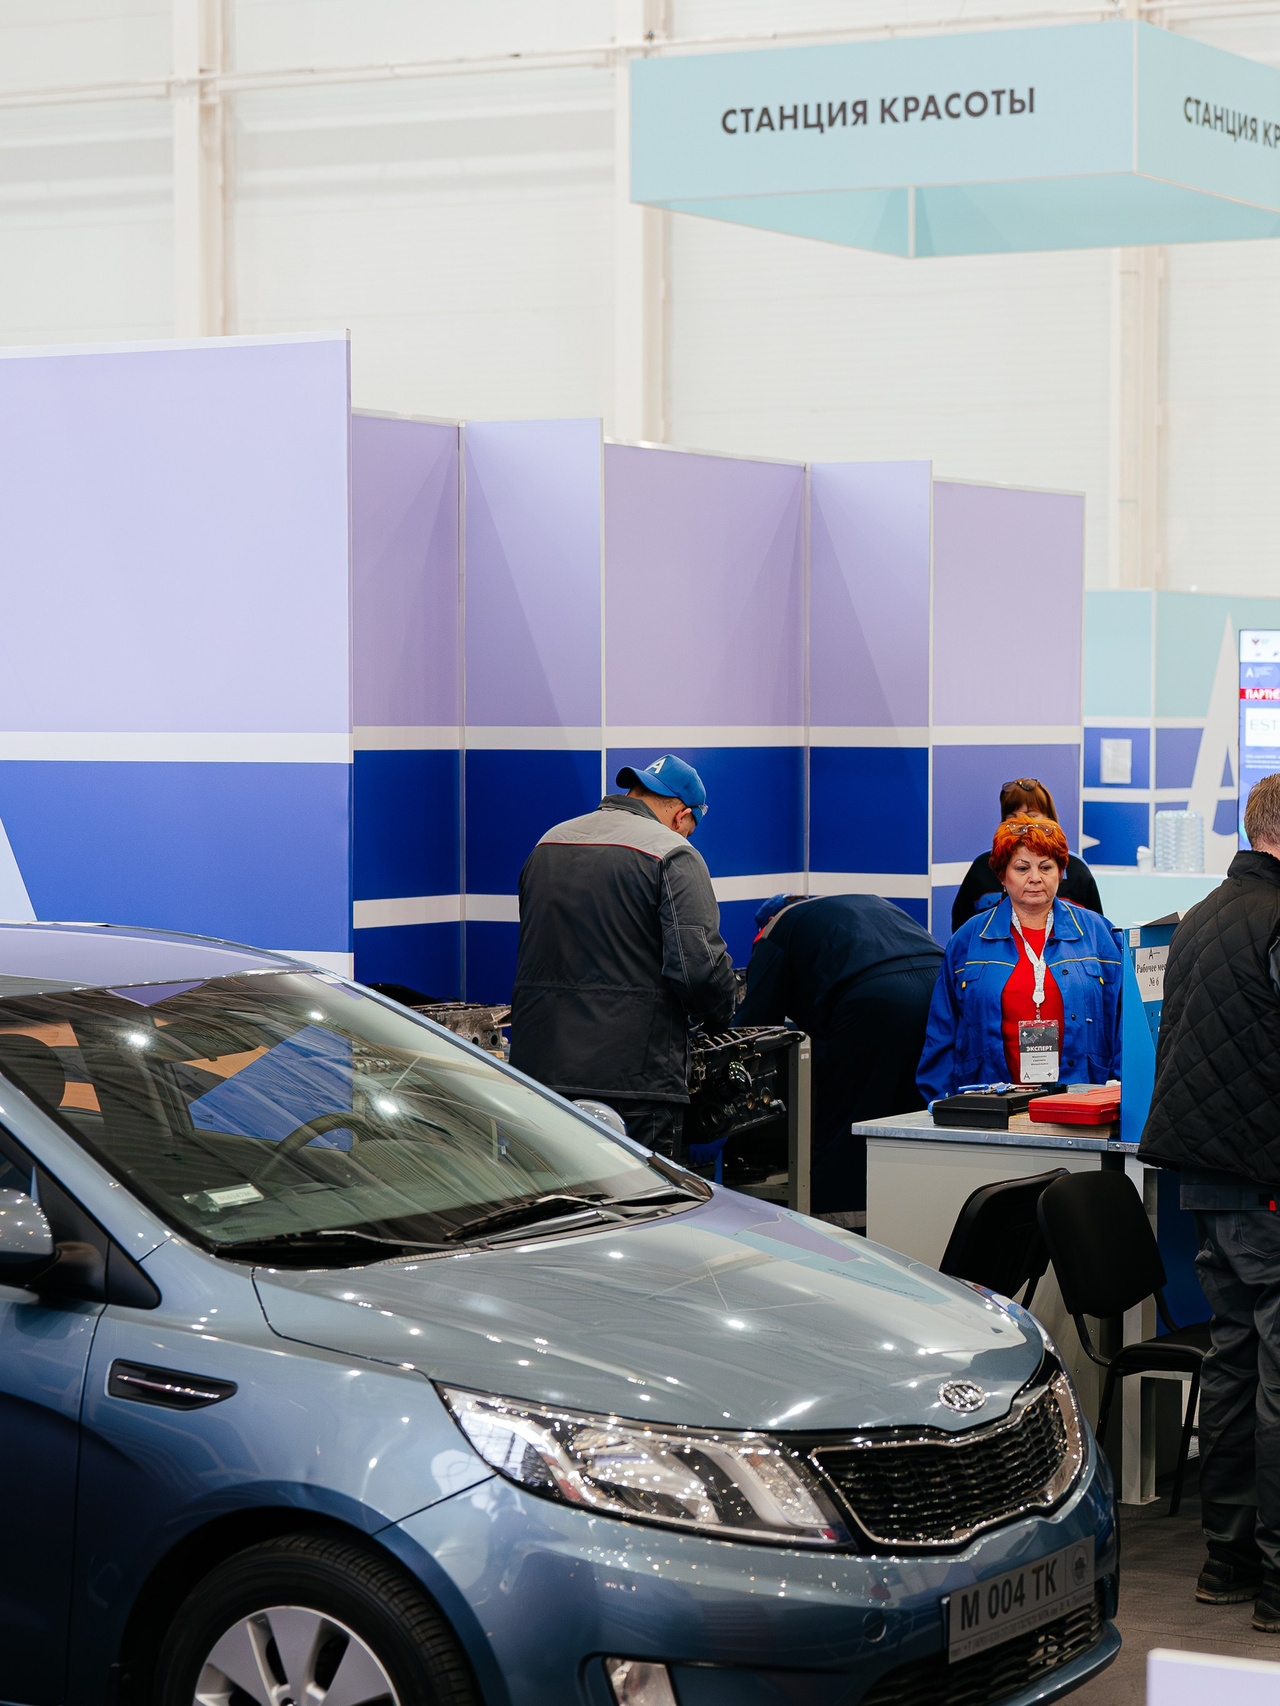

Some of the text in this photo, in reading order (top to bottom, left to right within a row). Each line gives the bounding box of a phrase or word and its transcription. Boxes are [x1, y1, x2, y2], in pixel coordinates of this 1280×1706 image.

[721, 87, 1036, 135] СТАНЦИЯ КРАСОТЫ
[1183, 96, 1258, 143] СТАНЦИЯ
[1137, 964, 1157, 973] Рабочее
[988, 1573, 1025, 1619] 004
